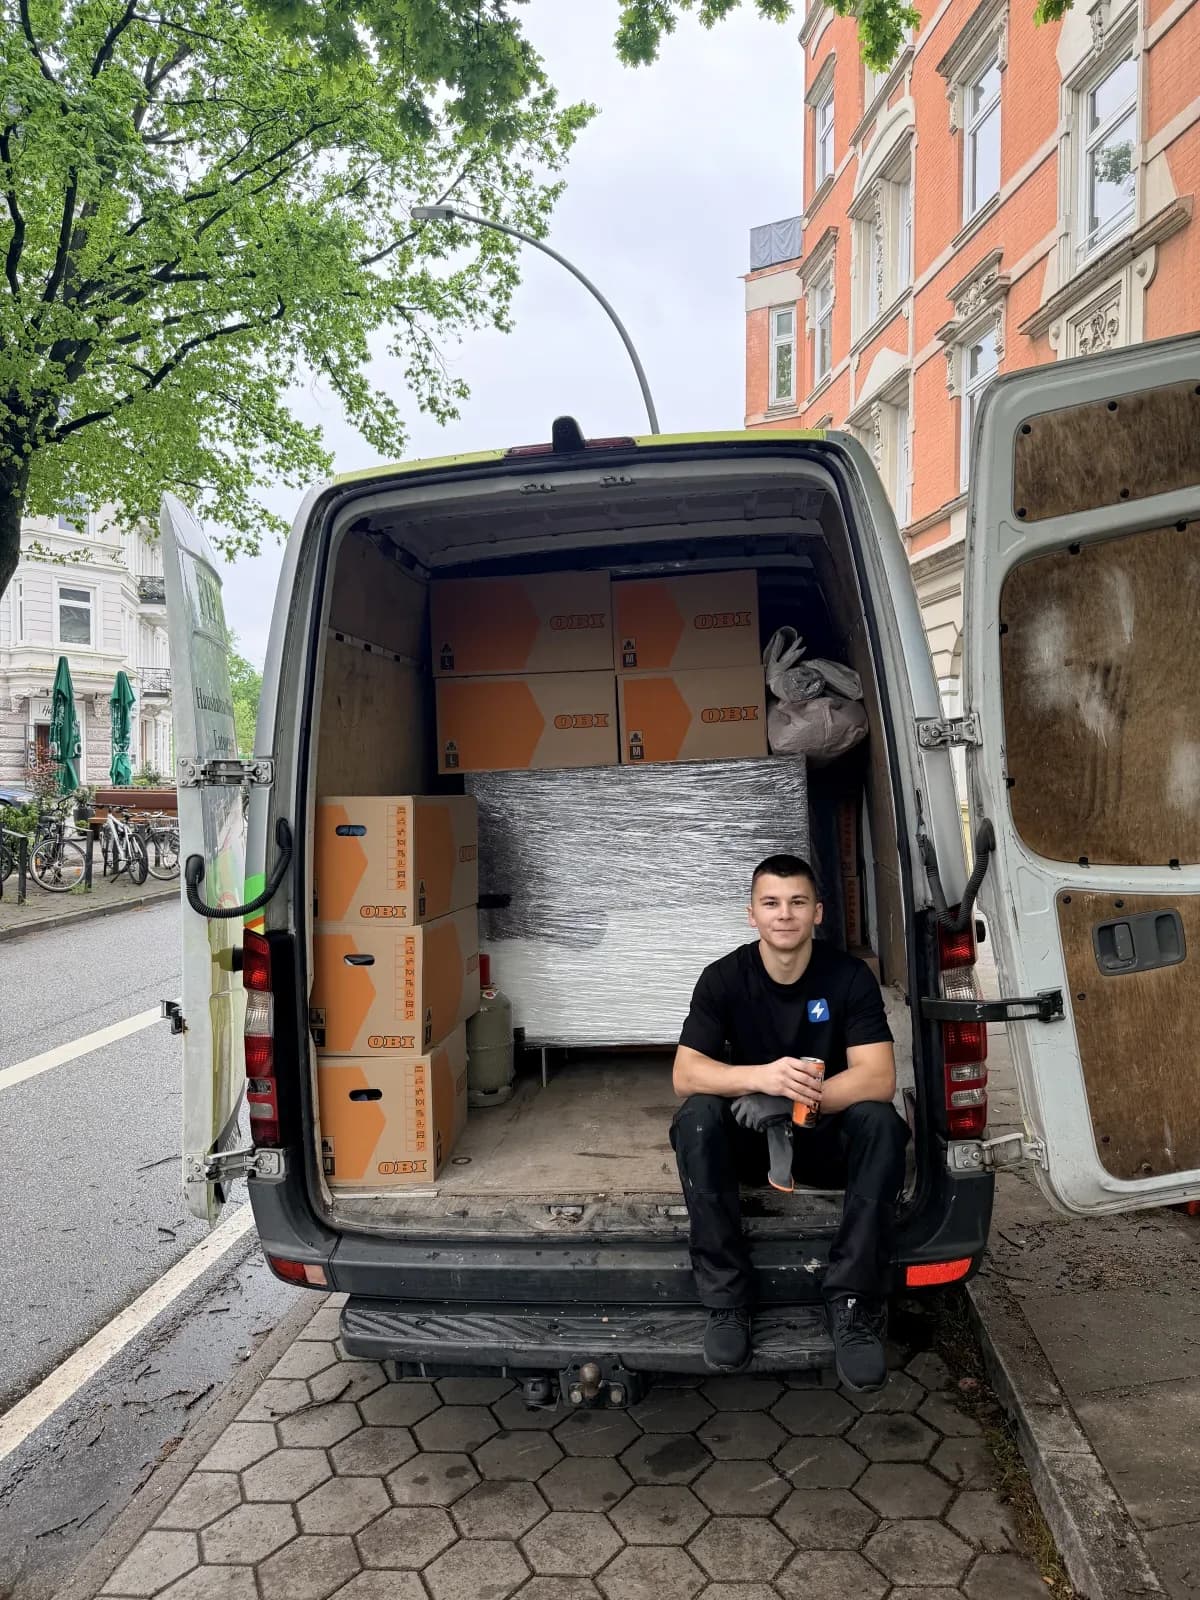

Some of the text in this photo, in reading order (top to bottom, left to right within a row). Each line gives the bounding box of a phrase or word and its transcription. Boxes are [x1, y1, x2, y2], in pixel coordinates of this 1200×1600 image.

[550, 614, 606, 629] OBI
[695, 612, 751, 629] OBI
[625, 654, 634, 664] M
[553, 714, 609, 729] OBI
[701, 706, 759, 723] OBI
[632, 746, 641, 755] M
[360, 905, 407, 918] OBI
[368, 1035, 415, 1048] OBI
[377, 1160, 427, 1175] OBI
